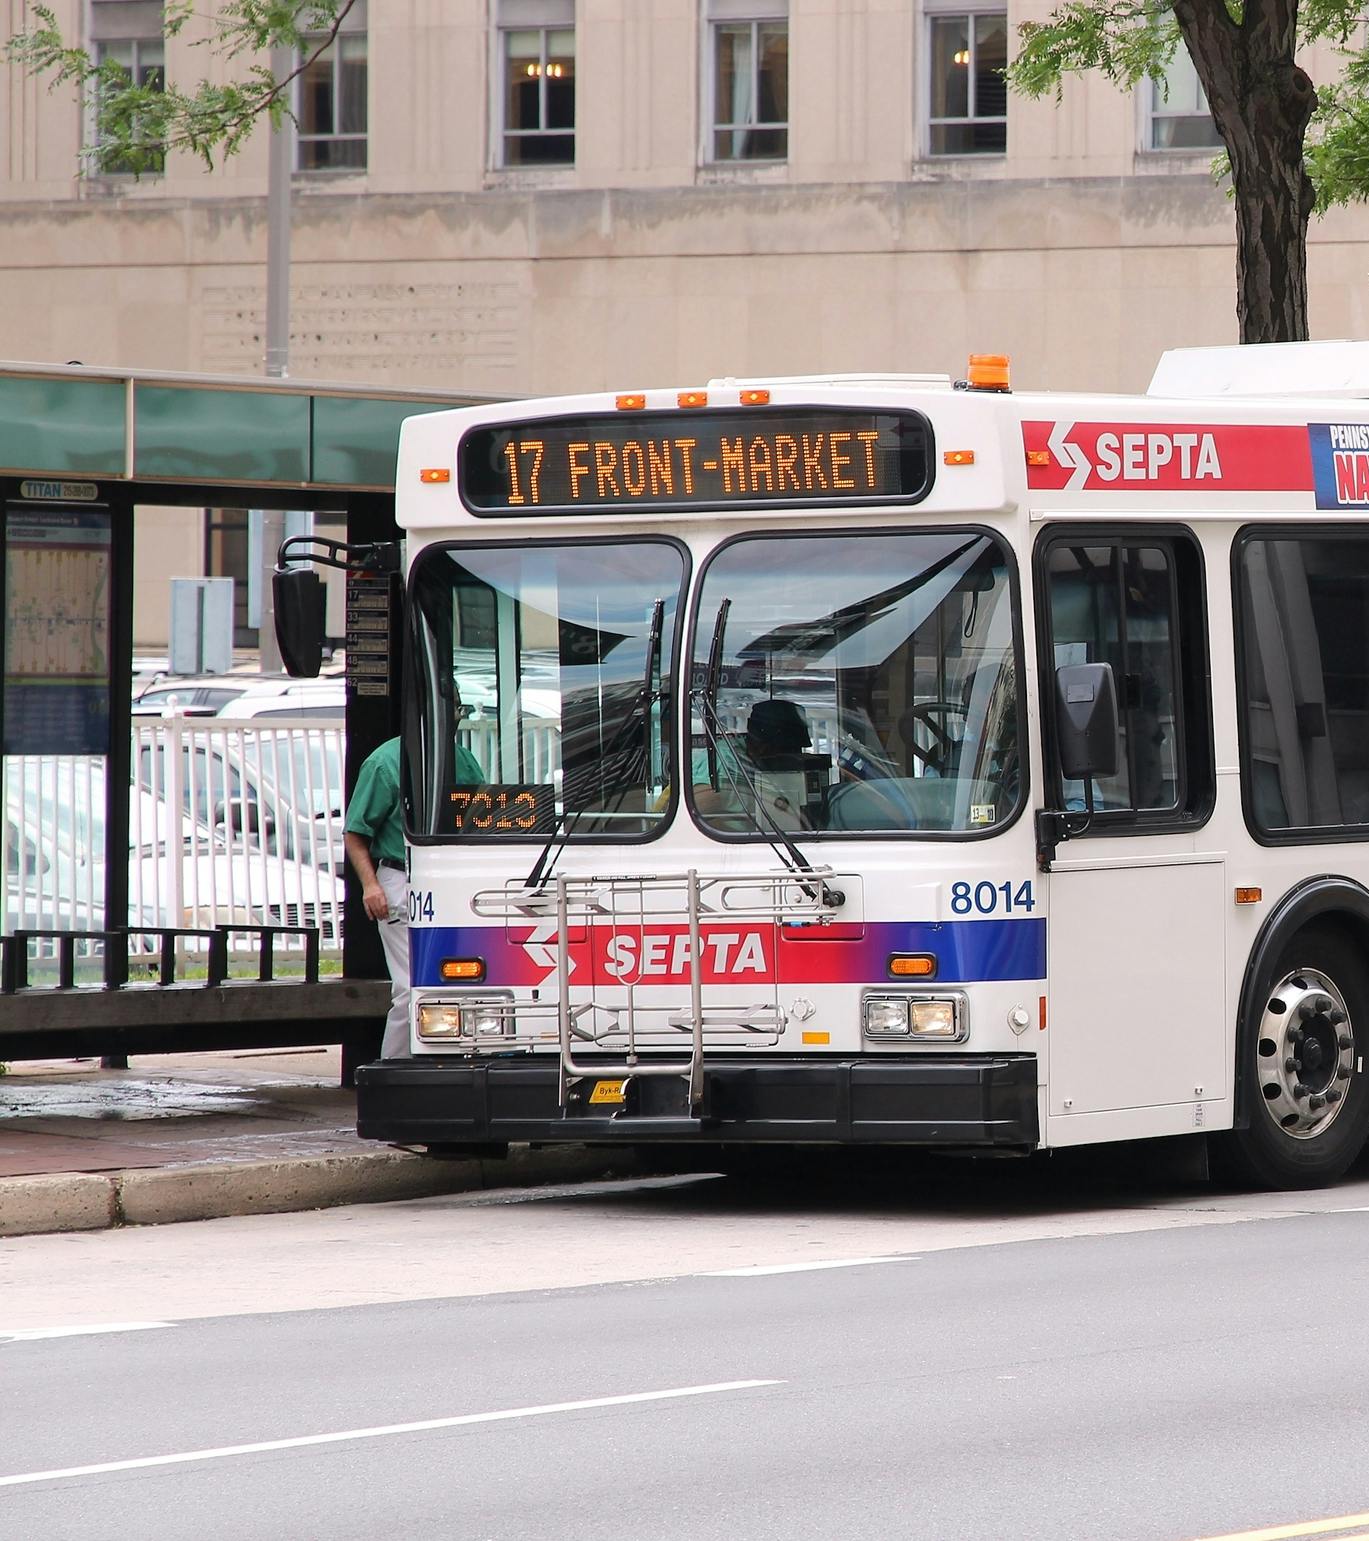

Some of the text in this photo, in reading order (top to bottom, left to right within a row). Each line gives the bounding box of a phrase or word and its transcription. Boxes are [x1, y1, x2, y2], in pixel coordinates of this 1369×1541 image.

[504, 431, 879, 504] 17 FRONT-MARKET
[1096, 432, 1222, 481] SEPTA
[26, 482, 61, 497] TITAN
[406, 890, 435, 922] 014
[950, 880, 1036, 915] 8014
[604, 933, 768, 977] SEPTA
